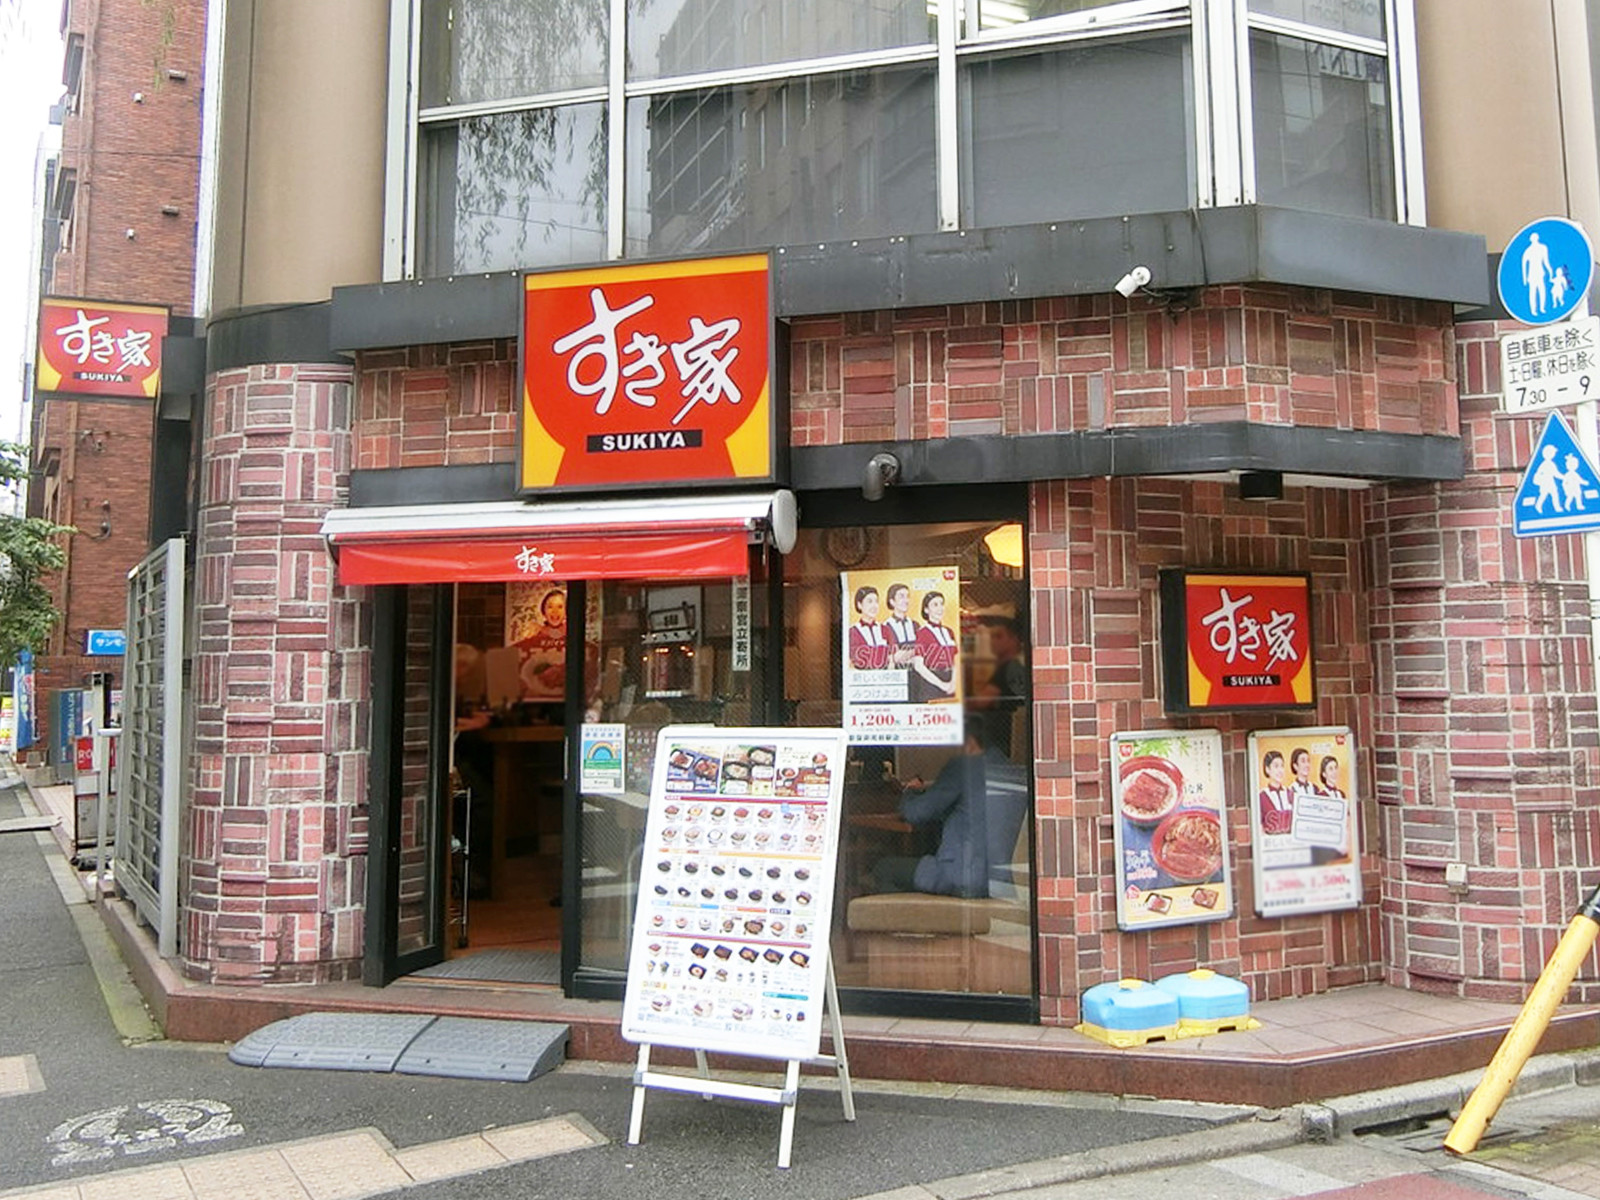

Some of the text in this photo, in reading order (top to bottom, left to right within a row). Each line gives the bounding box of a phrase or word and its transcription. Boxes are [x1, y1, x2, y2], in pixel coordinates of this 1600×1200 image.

[55, 309, 153, 373] すき家
[553, 288, 743, 425] すき家
[1506, 328, 1593, 360] 自転車を除く
[79, 371, 125, 383] SUKIYA
[1580, 375, 1591, 396] 9
[602, 431, 687, 451] SUKIYA
[514, 545, 555, 576] すき家
[1201, 588, 1299, 671] すき家
[1230, 675, 1273, 687] SUKIYA
